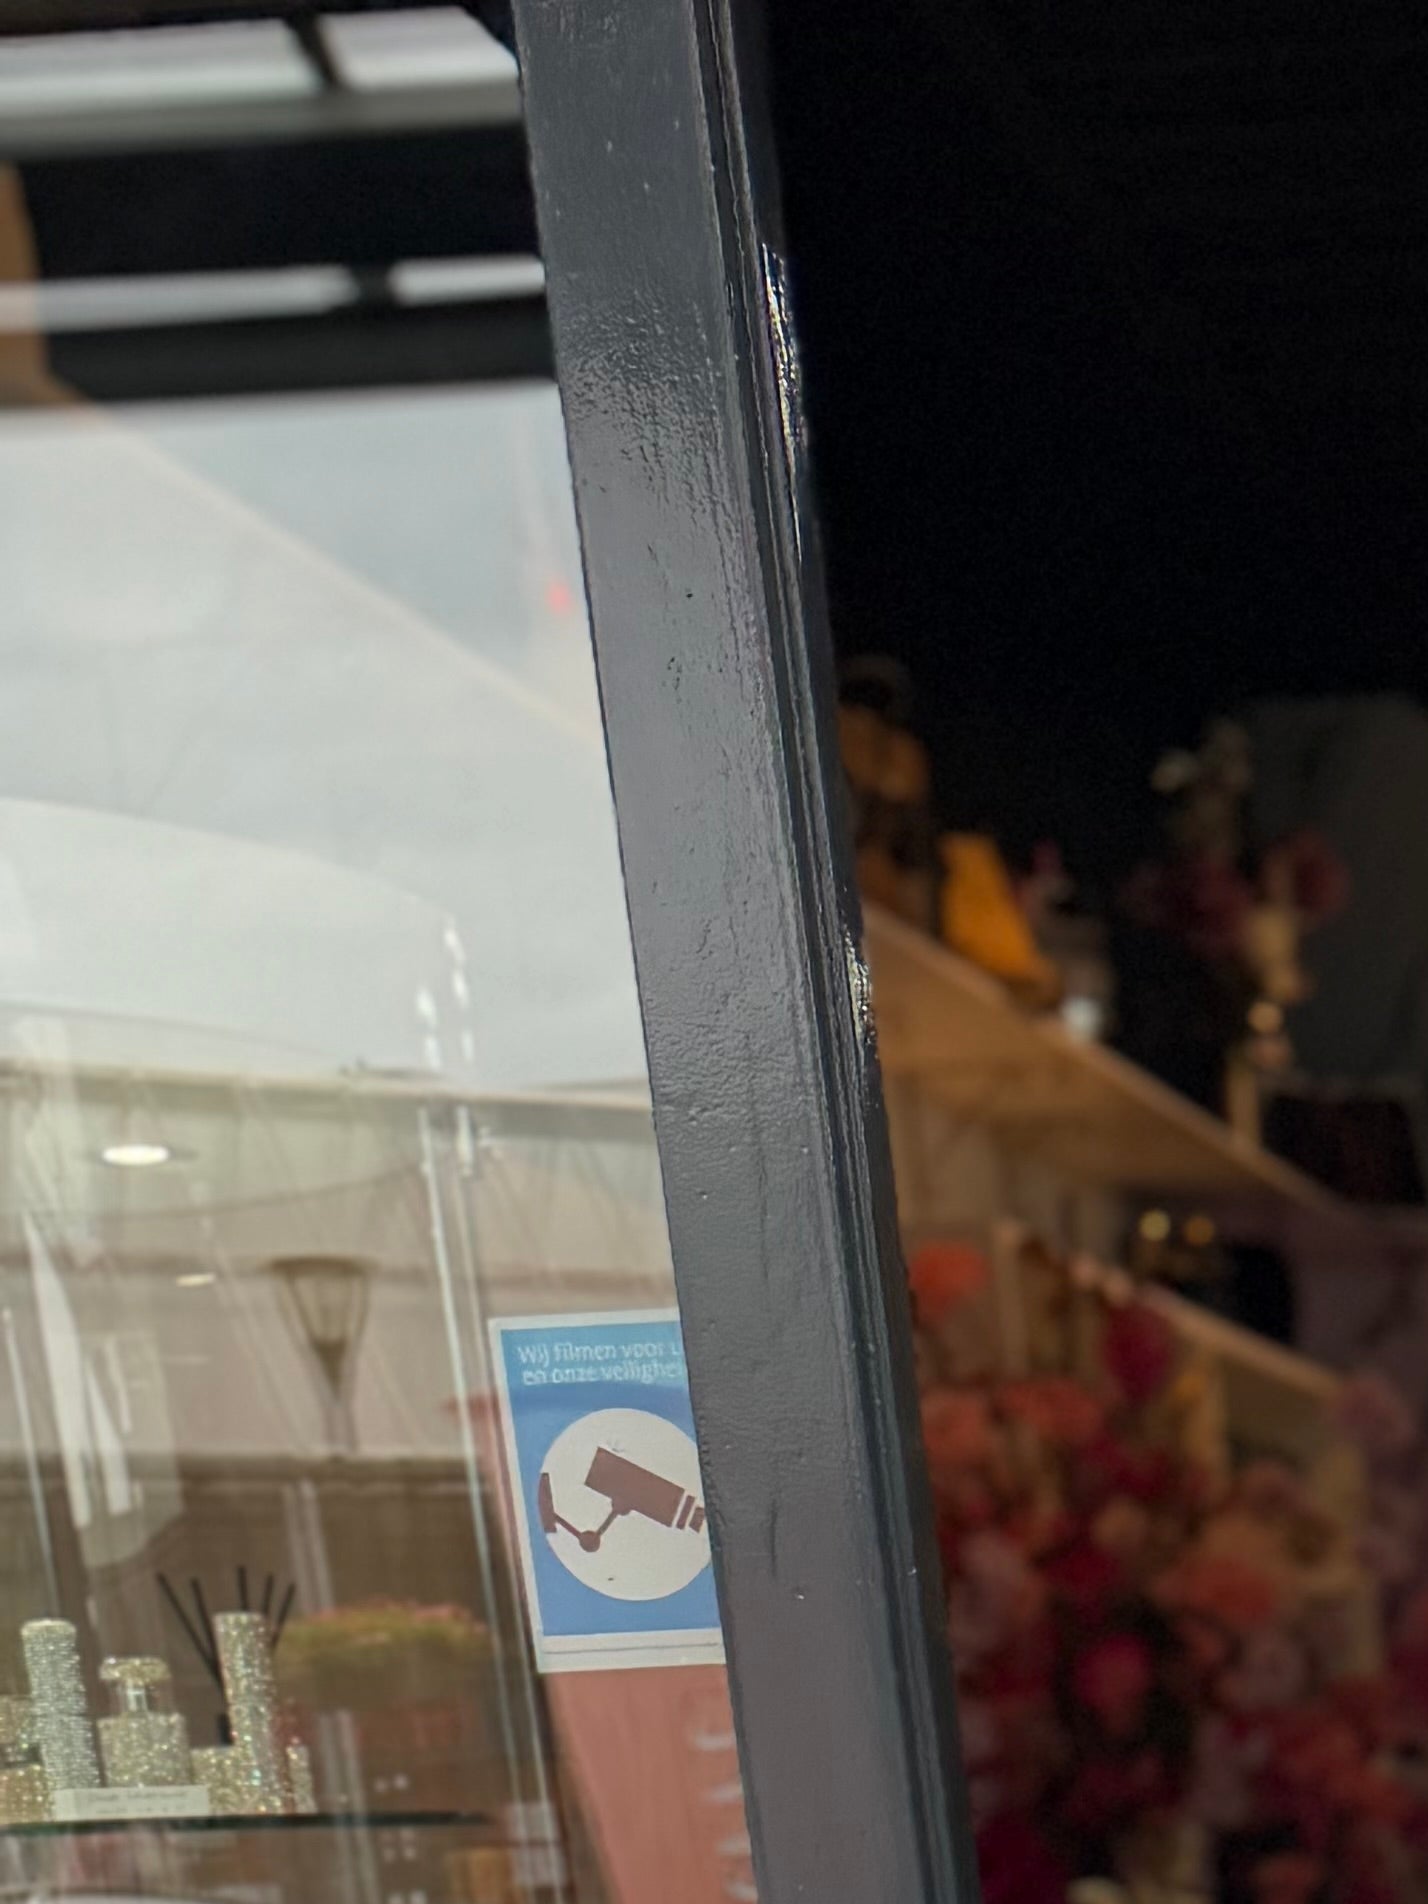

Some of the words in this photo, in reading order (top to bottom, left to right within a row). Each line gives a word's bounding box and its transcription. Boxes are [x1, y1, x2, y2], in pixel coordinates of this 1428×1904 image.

[518, 1344, 550, 1367] Wij
[553, 1341, 617, 1362] filmen
[621, 1341, 665, 1358] voor
[522, 1369, 547, 1385] en
[552, 1366, 599, 1383] onze
[600, 1359, 683, 1384] veilighei
